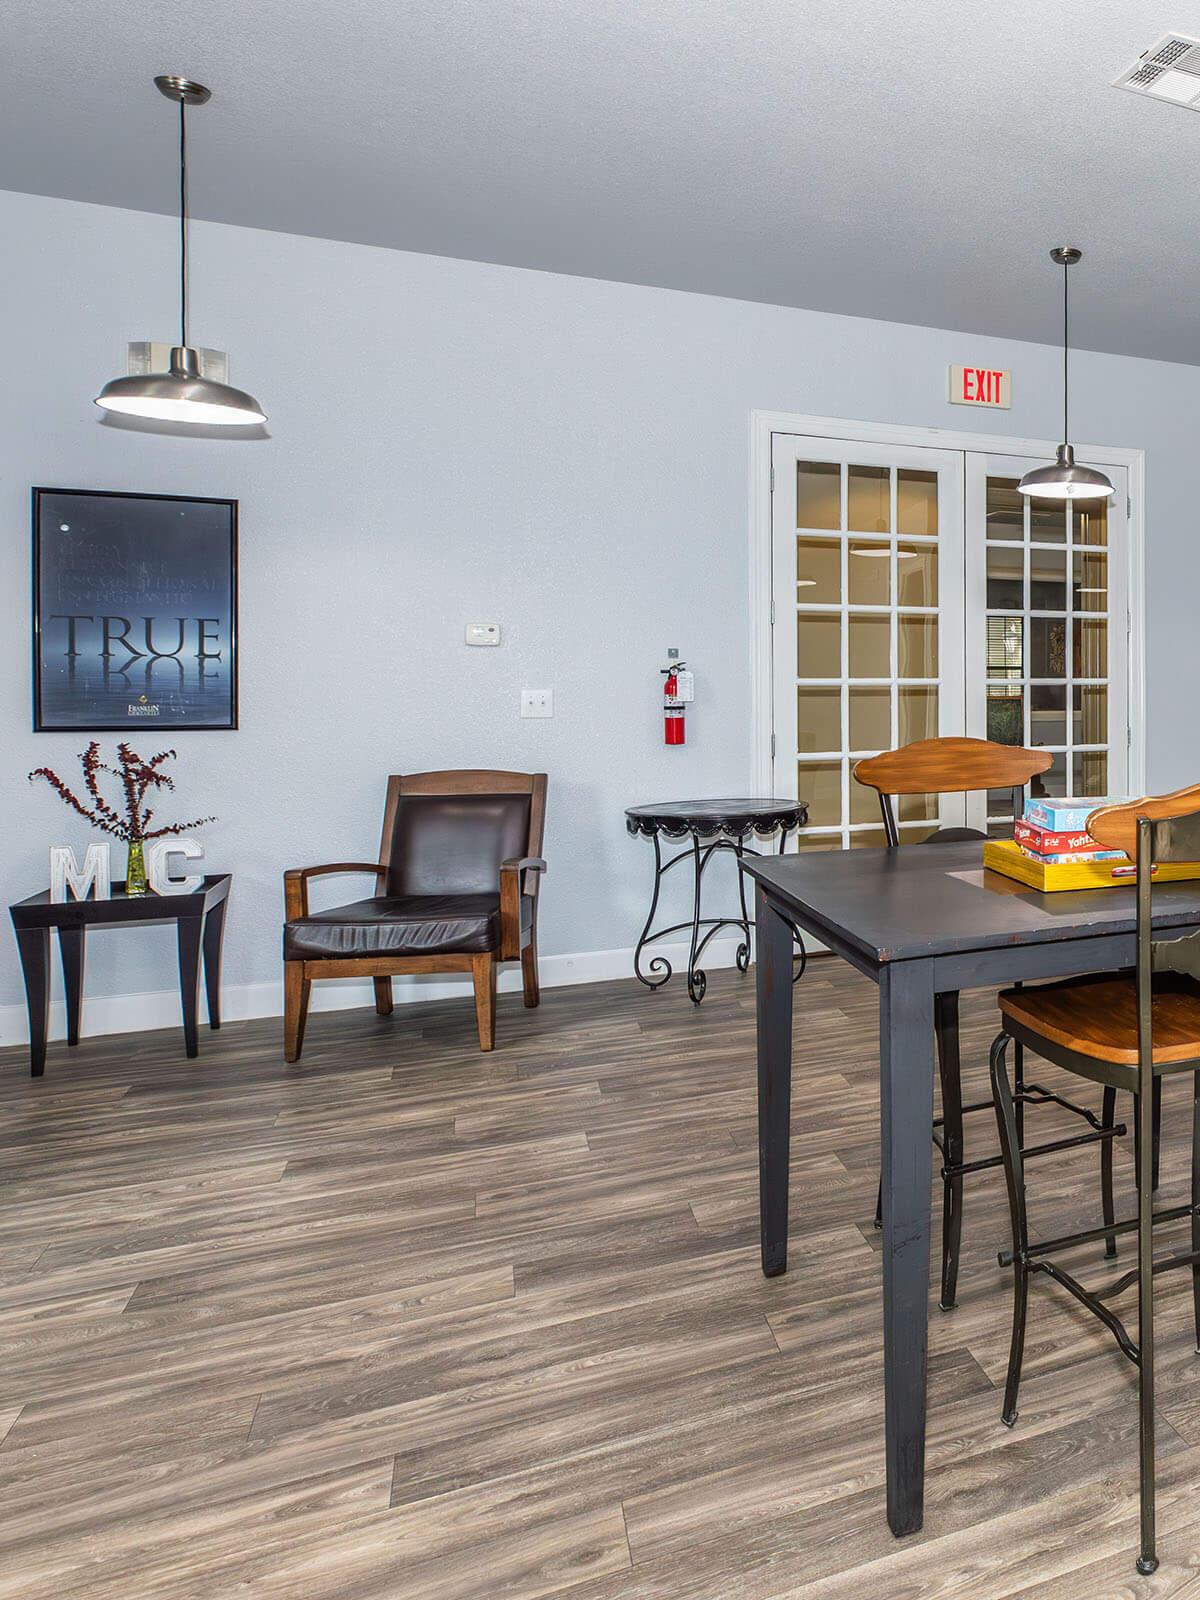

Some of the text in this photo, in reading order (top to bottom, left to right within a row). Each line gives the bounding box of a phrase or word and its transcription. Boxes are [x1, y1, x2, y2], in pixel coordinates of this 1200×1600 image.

[963, 367, 1003, 403] EXIT
[50, 614, 222, 657] TRUE
[49, 838, 205, 904] M C
